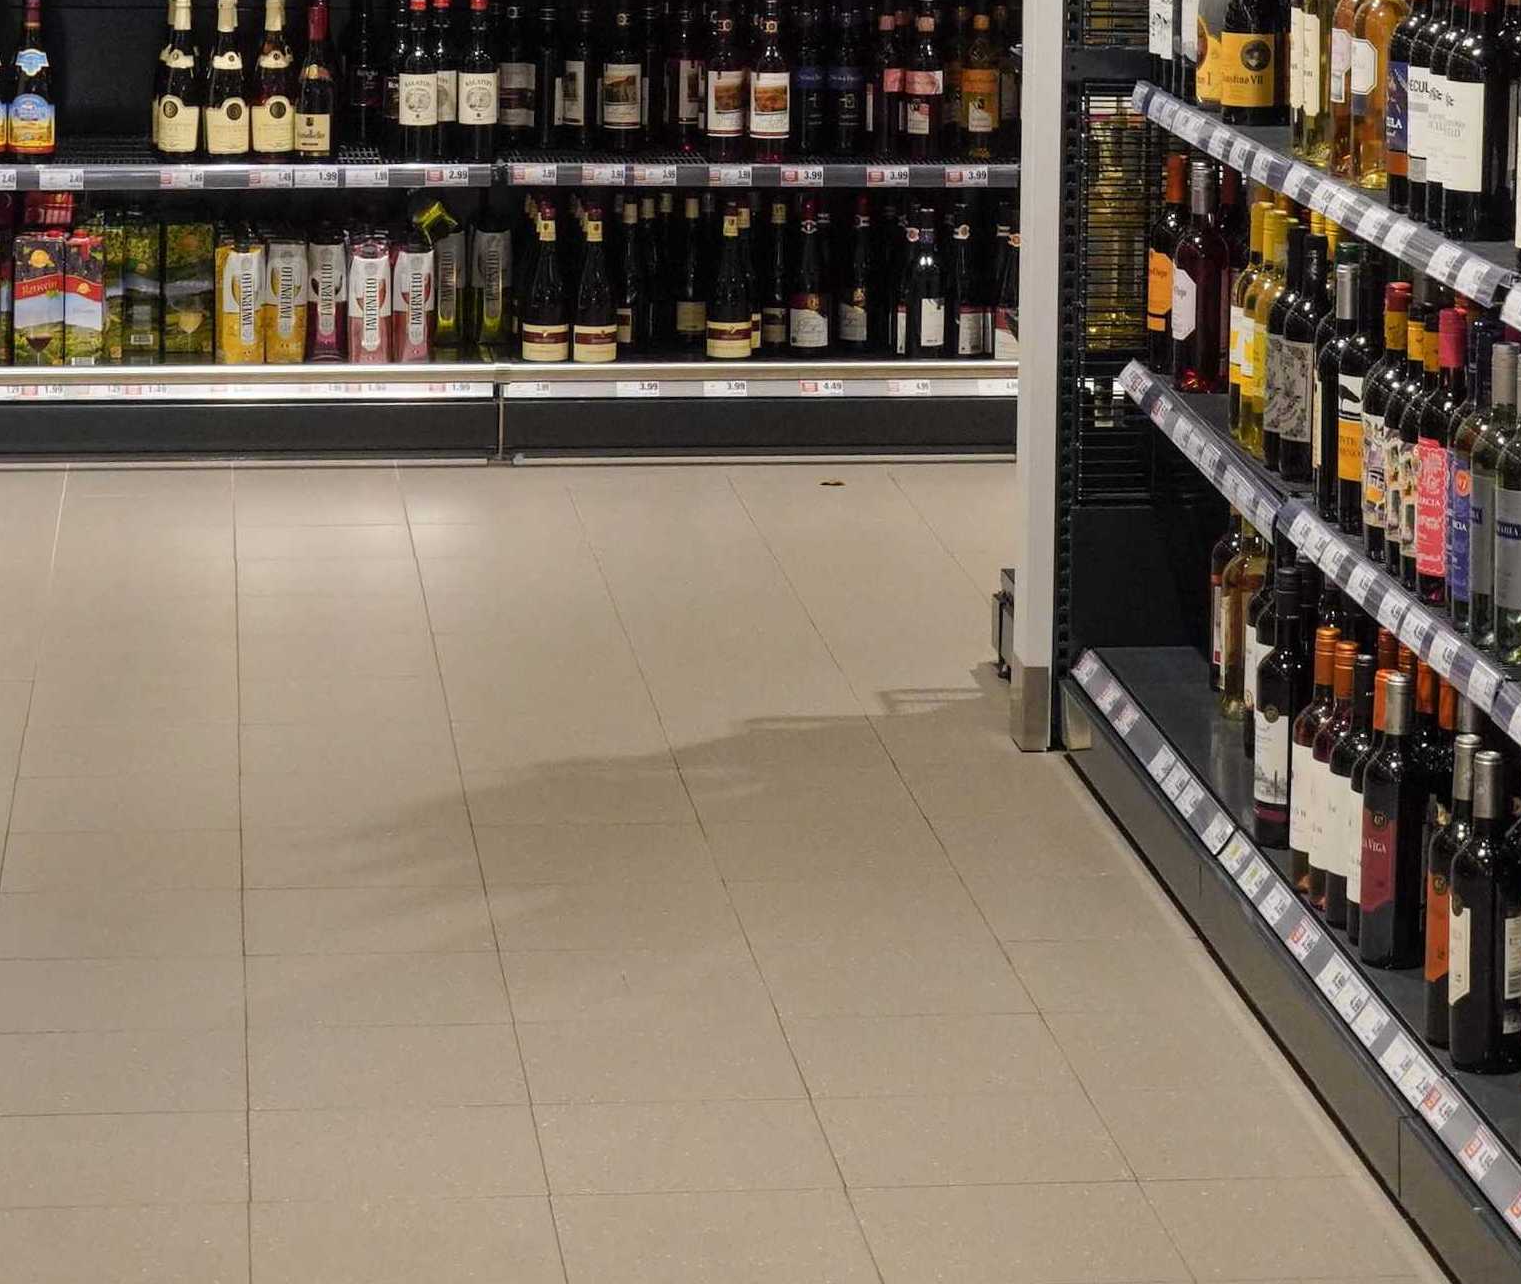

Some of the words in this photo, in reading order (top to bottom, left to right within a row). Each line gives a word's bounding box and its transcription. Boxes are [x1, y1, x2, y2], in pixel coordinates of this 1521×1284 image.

[319, 171, 338, 181] 1.99
[448, 170, 468, 180] 2.99
[804, 170, 823, 180] 3.99
[890, 171, 908, 181] 3.99
[968, 170, 987, 180] 3.99
[639, 382, 659, 392] 3.99
[727, 382, 746, 392] 3.99
[823, 381, 842, 391] 4.49
